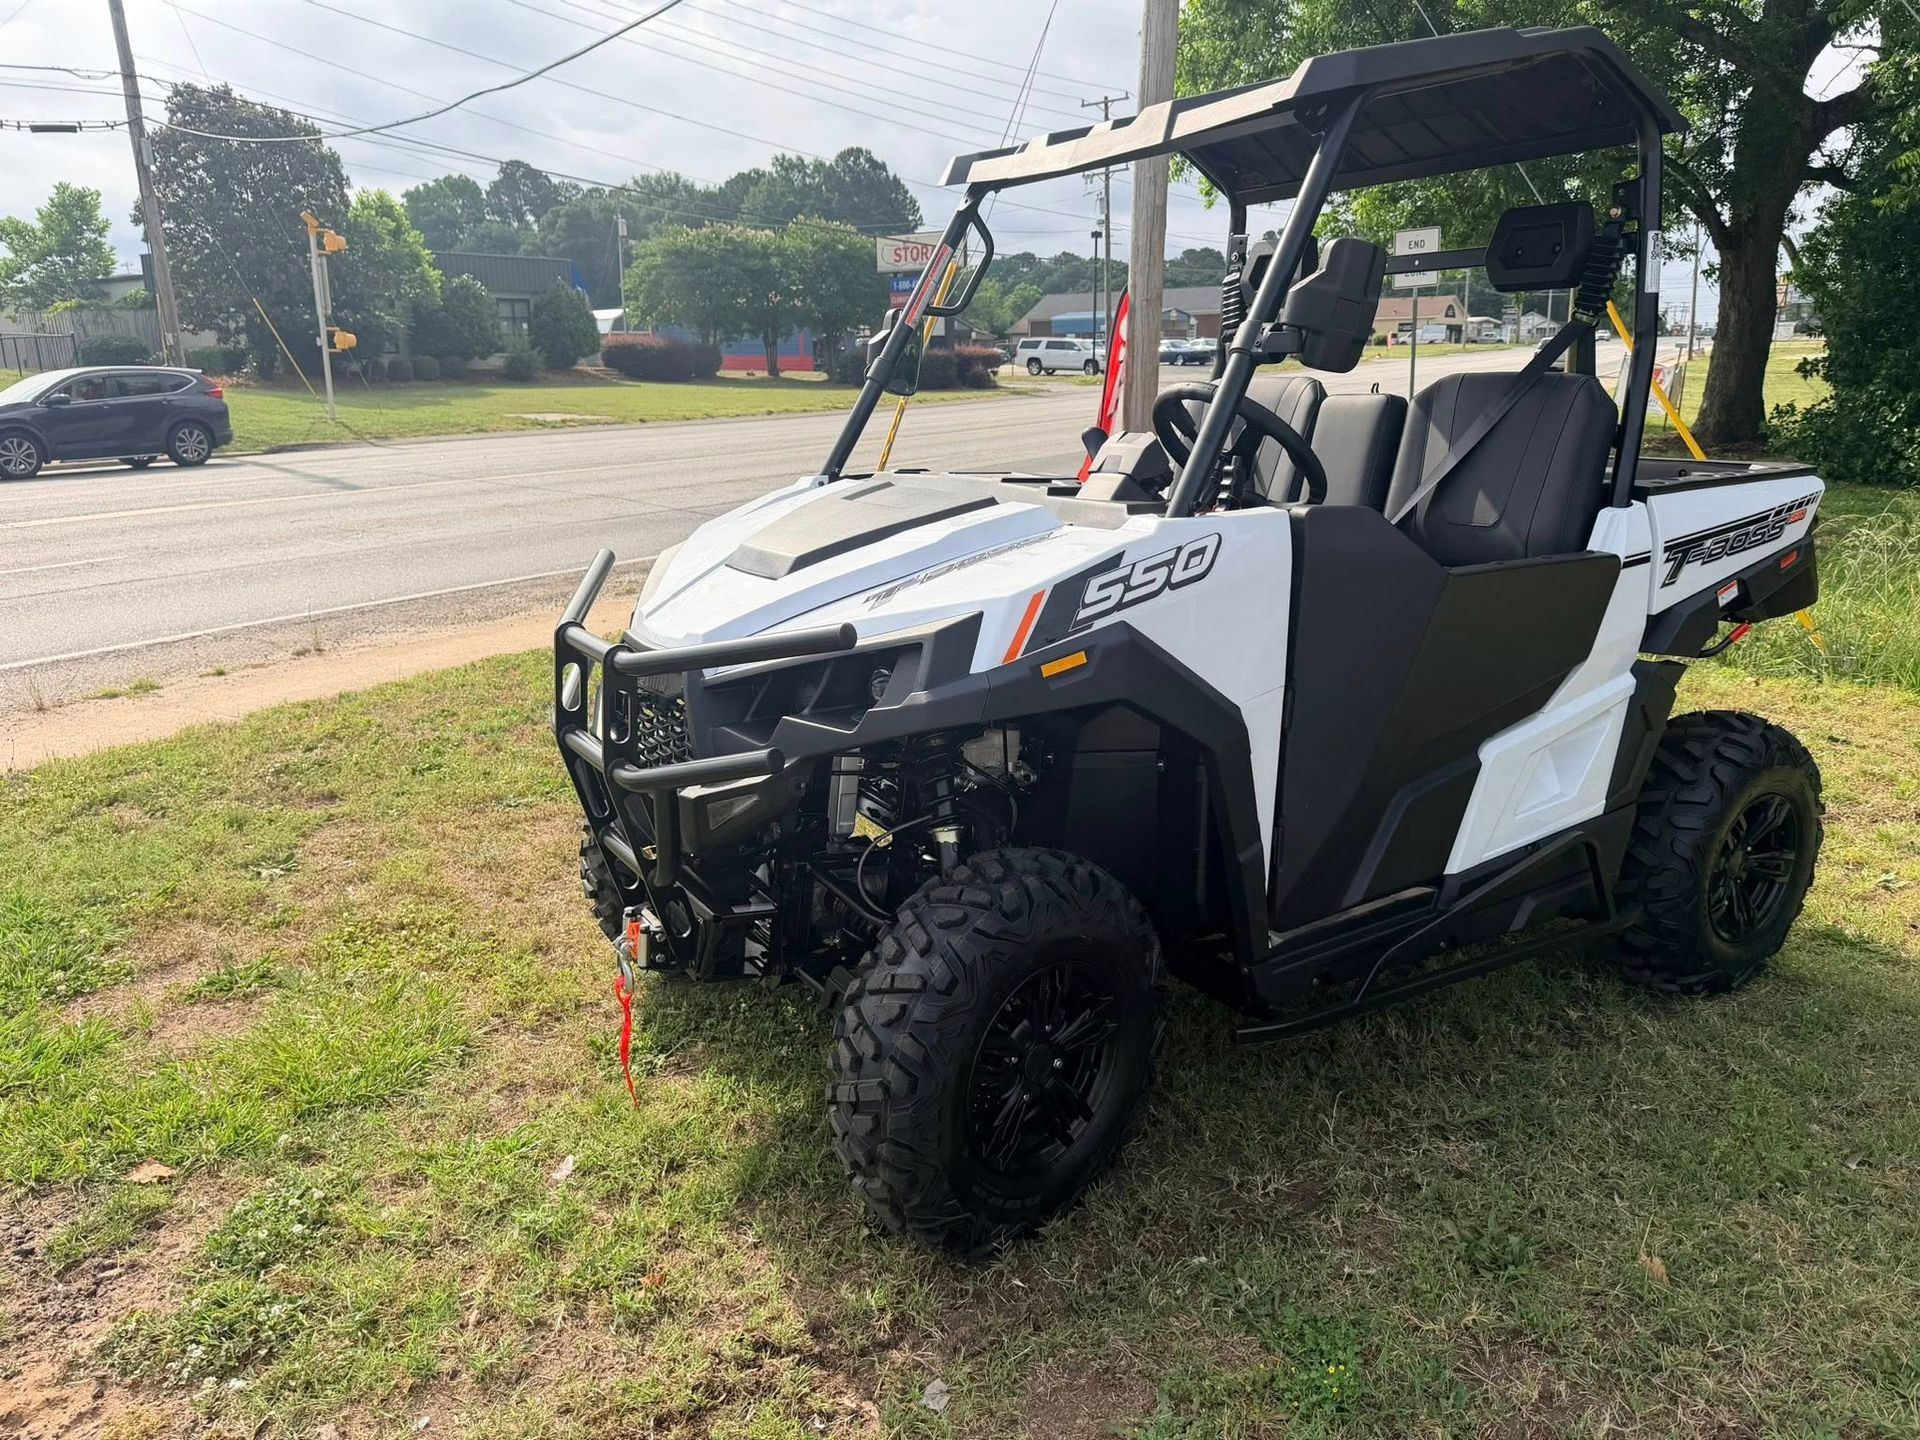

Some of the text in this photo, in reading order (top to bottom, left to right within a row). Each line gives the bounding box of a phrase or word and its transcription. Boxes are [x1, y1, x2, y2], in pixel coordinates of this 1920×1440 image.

[893, 245, 935, 263] STOR
[1408, 239, 1425, 250] END
[1661, 517, 1788, 589] T-BOSS
[1069, 532, 1222, 632] 550
